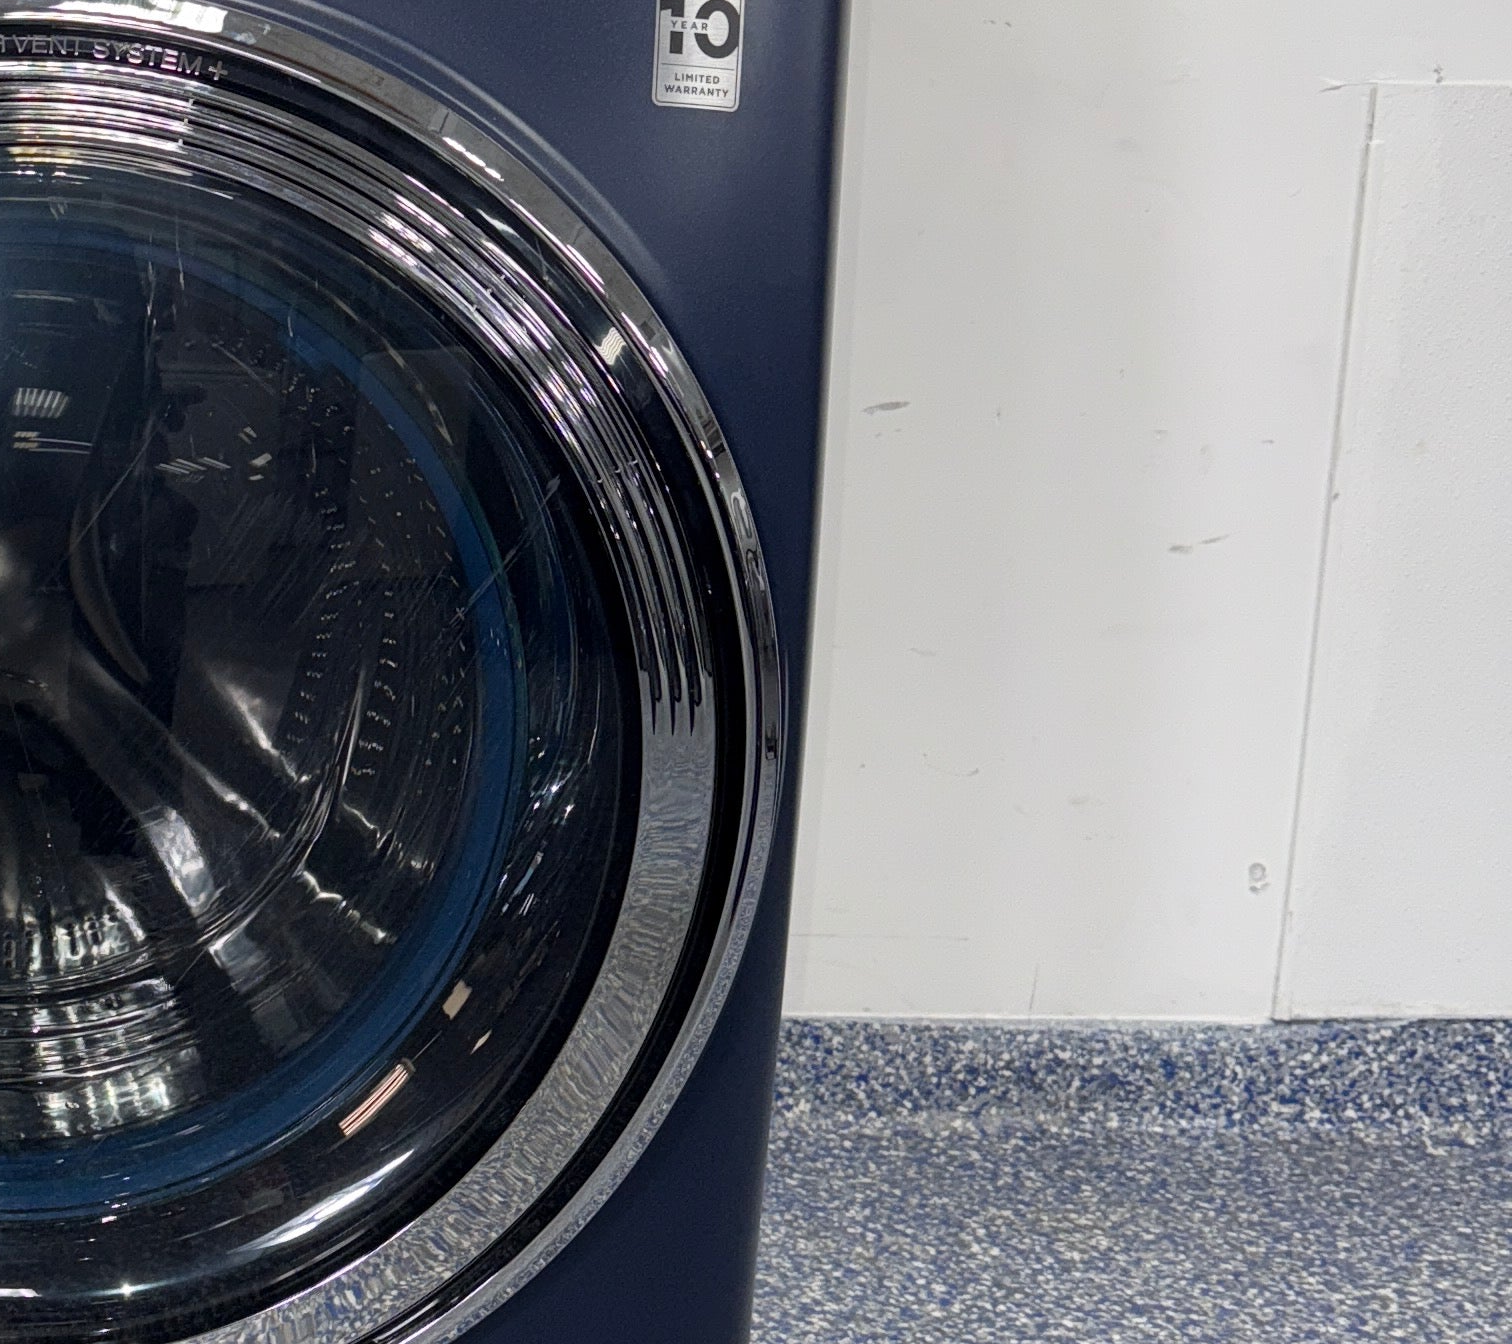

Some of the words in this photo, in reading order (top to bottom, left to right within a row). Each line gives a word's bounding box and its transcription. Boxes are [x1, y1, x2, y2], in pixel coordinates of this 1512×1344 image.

[671, 20, 709, 32] YEAR
[13, 34, 82, 56] VENT
[93, 39, 203, 76] SYSTEM
[674, 72, 720, 84] LIMITED
[664, 84, 729, 98] WARRANTY
